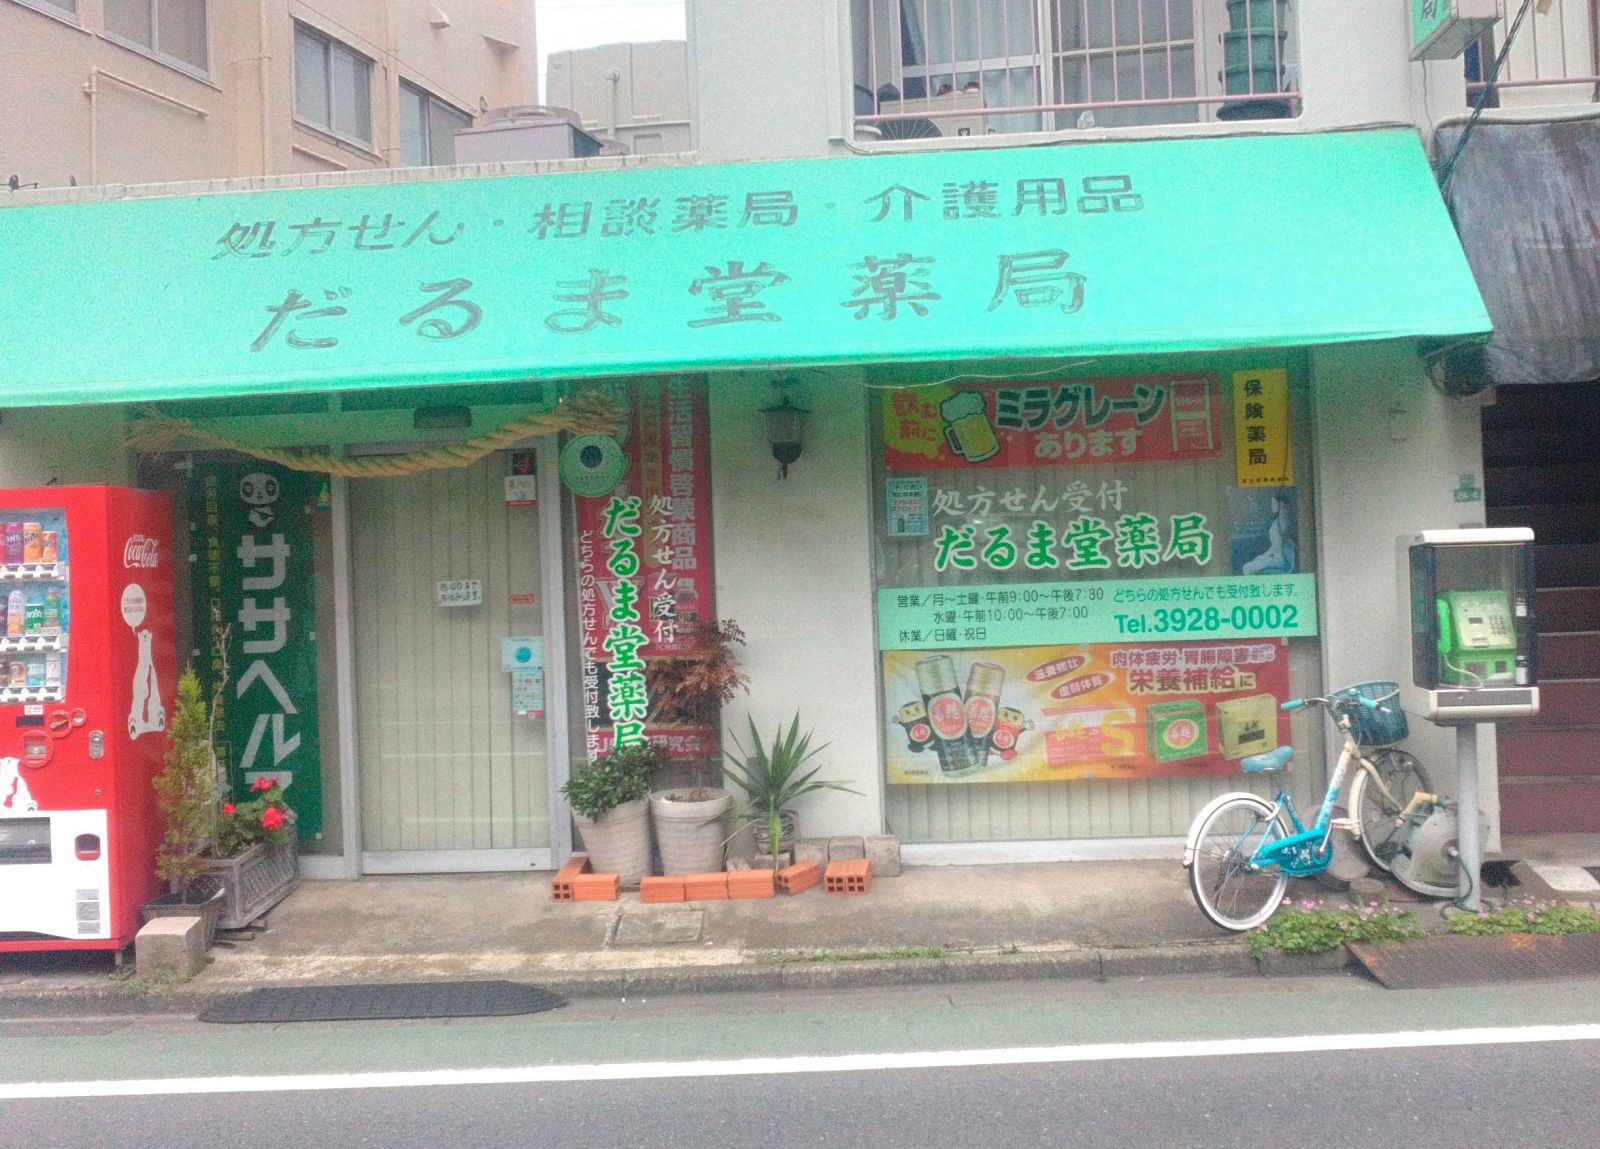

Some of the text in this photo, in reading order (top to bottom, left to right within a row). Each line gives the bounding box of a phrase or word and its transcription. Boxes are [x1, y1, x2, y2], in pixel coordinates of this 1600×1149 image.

[252, 246, 1092, 352] だるま堂薬局
[995, 382, 1167, 431] ミラグレーン
[1243, 378, 1268, 466] 保険薬局
[1035, 428, 1142, 459] あります
[931, 480, 1128, 517] 処方せん受付
[932, 511, 1214, 572] だるま堂薬局
[649, 494, 680, 644] 処方せん受付
[1113, 583, 1299, 603] どちらの処方せんでも受付致します。
[1113, 604, 1299, 634] Tel.3928-0002
[1129, 667, 1255, 693] 栄養補給に
